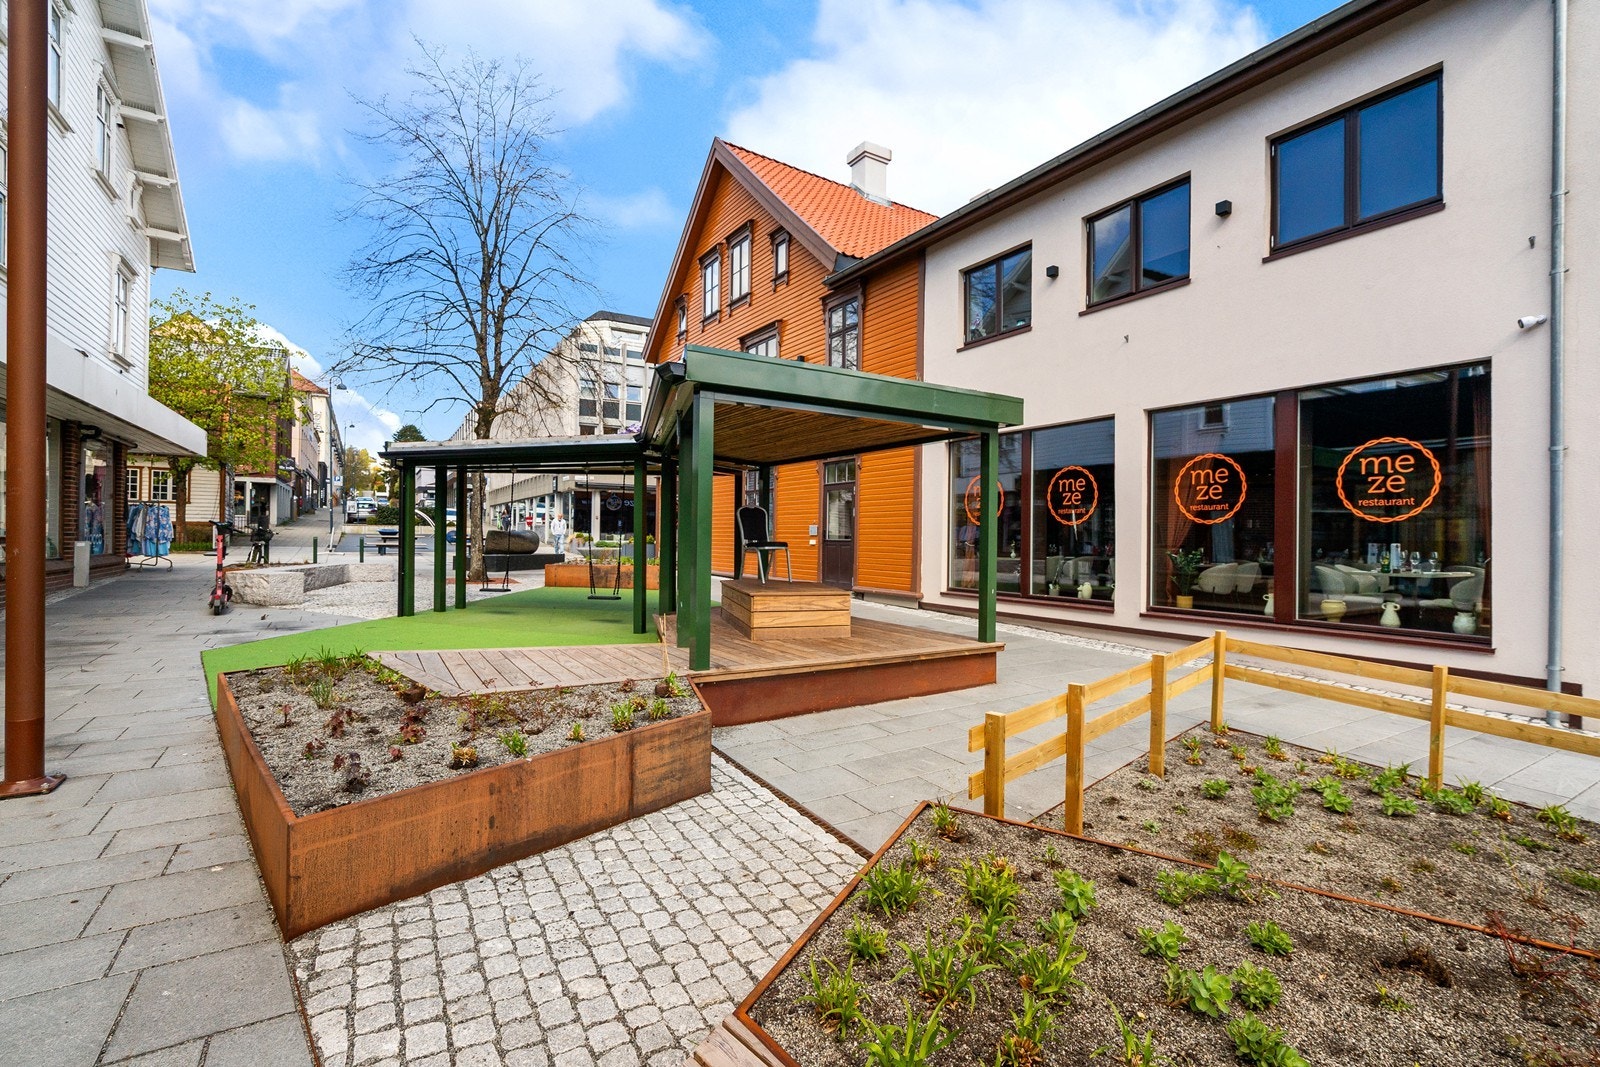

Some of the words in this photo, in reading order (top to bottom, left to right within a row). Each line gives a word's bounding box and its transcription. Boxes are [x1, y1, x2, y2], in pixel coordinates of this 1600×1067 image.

[1359, 454, 1415, 475] me
[1190, 468, 1229, 485] me
[1059, 478, 1086, 492] me
[1367, 475, 1406, 494] ze
[1062, 492, 1081, 505] ze
[1196, 485, 1223, 500] ze
[1190, 503, 1229, 511] restaurant
[1358, 497, 1416, 507] restaurant
